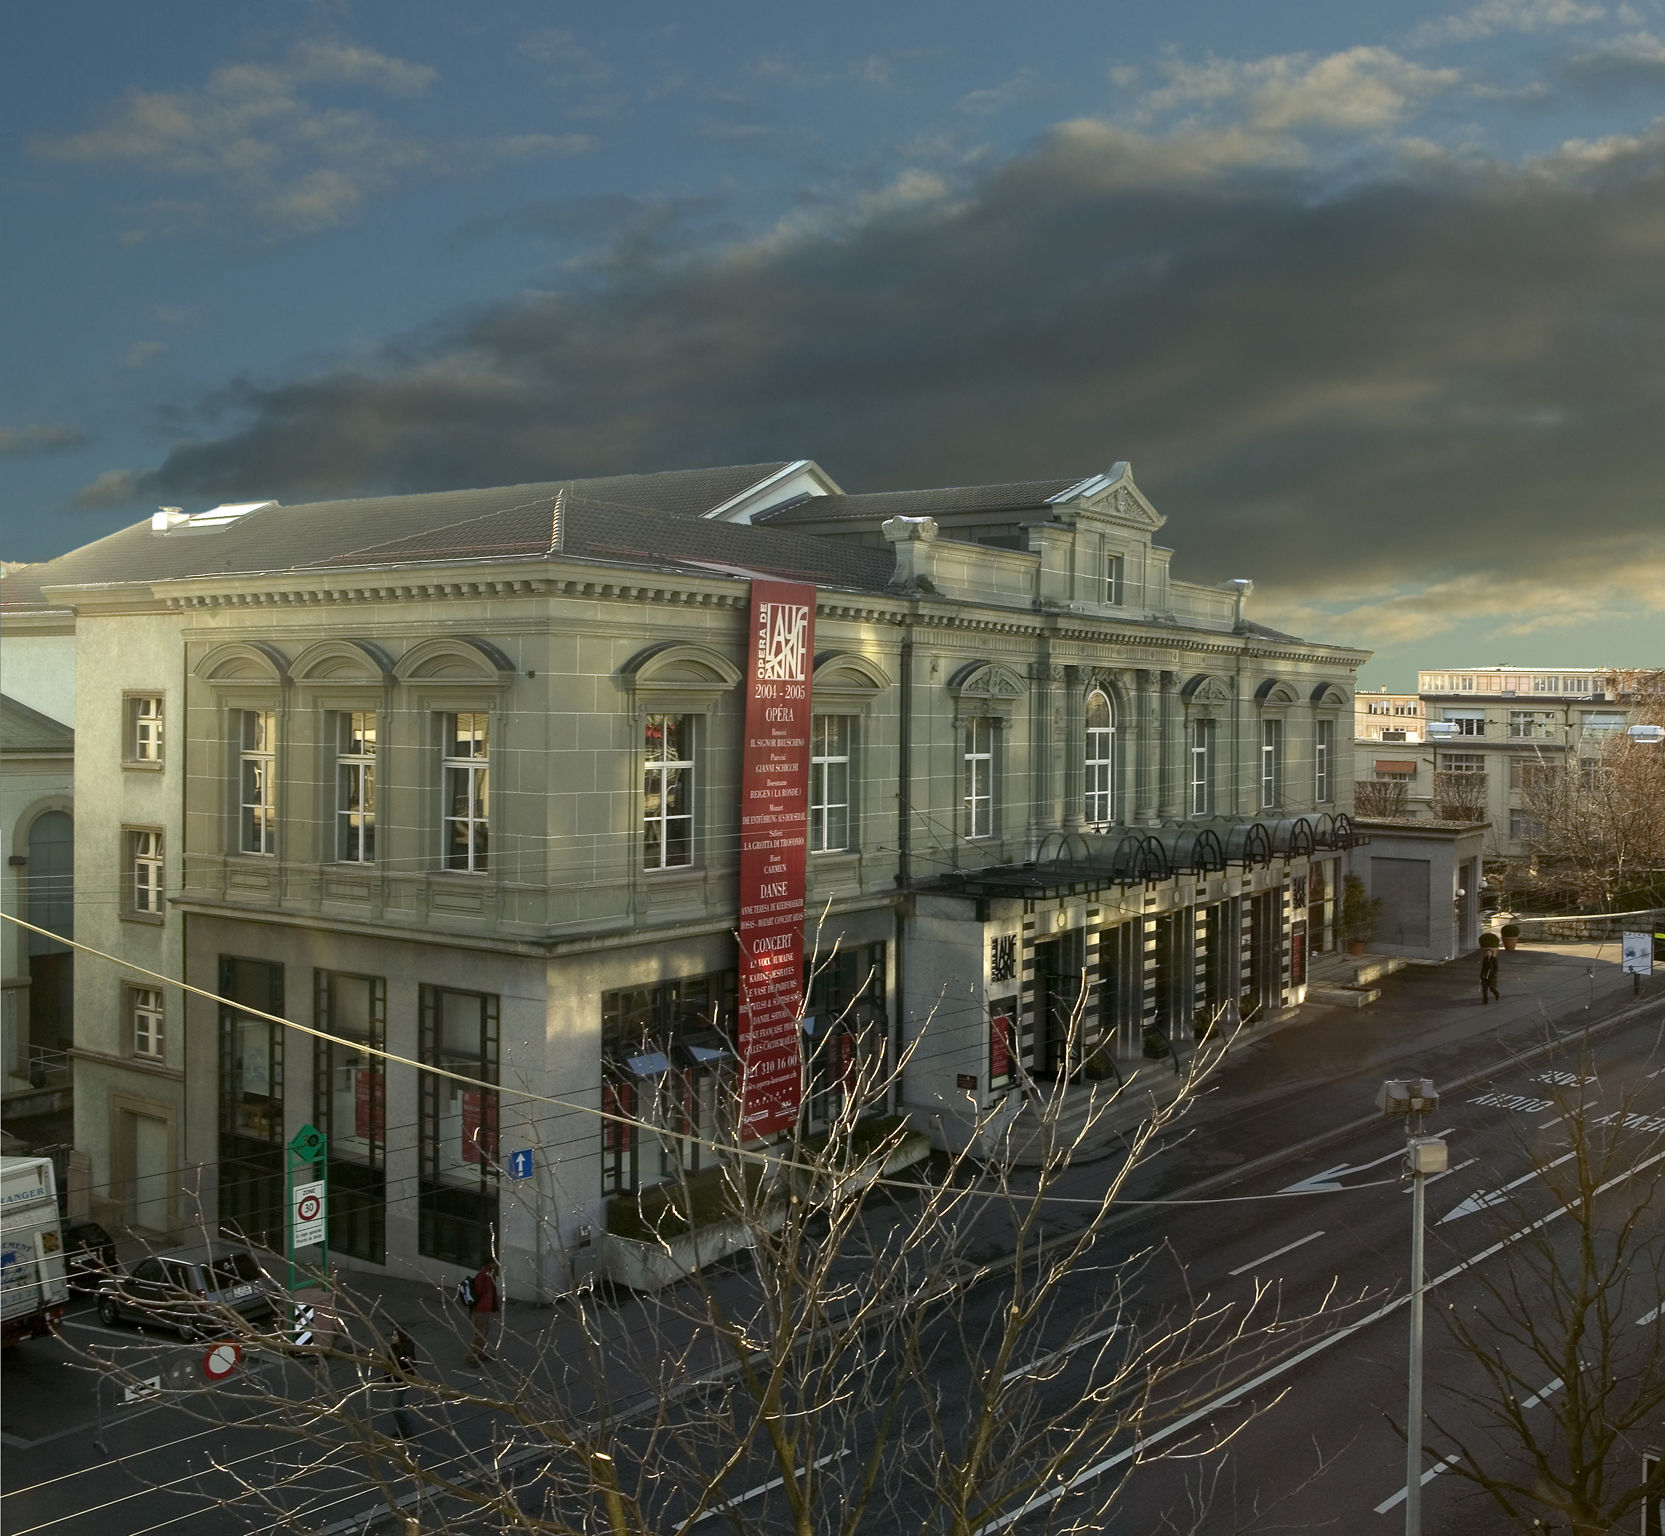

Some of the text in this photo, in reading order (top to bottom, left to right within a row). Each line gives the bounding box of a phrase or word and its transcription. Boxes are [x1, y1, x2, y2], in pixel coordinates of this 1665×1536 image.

[755, 684, 777, 699] 2004
[785, 685, 806, 699] 2005
[765, 704, 794, 722] OPÉRA
[755, 764, 775, 773] GIANNI
[750, 789, 770, 799] REIGEN
[744, 842, 752, 850] LA
[763, 864, 787, 874] CARMEN
[760, 881, 788, 899] DANSE
[753, 933, 793, 954] CONCERT
[761, 1061, 775, 1075] 310
[777, 1058, 786, 1071] 16
[787, 1055, 797, 1067] 00
[303, 1187, 316, 1196] ZONE
[304, 1202, 314, 1214] 30
